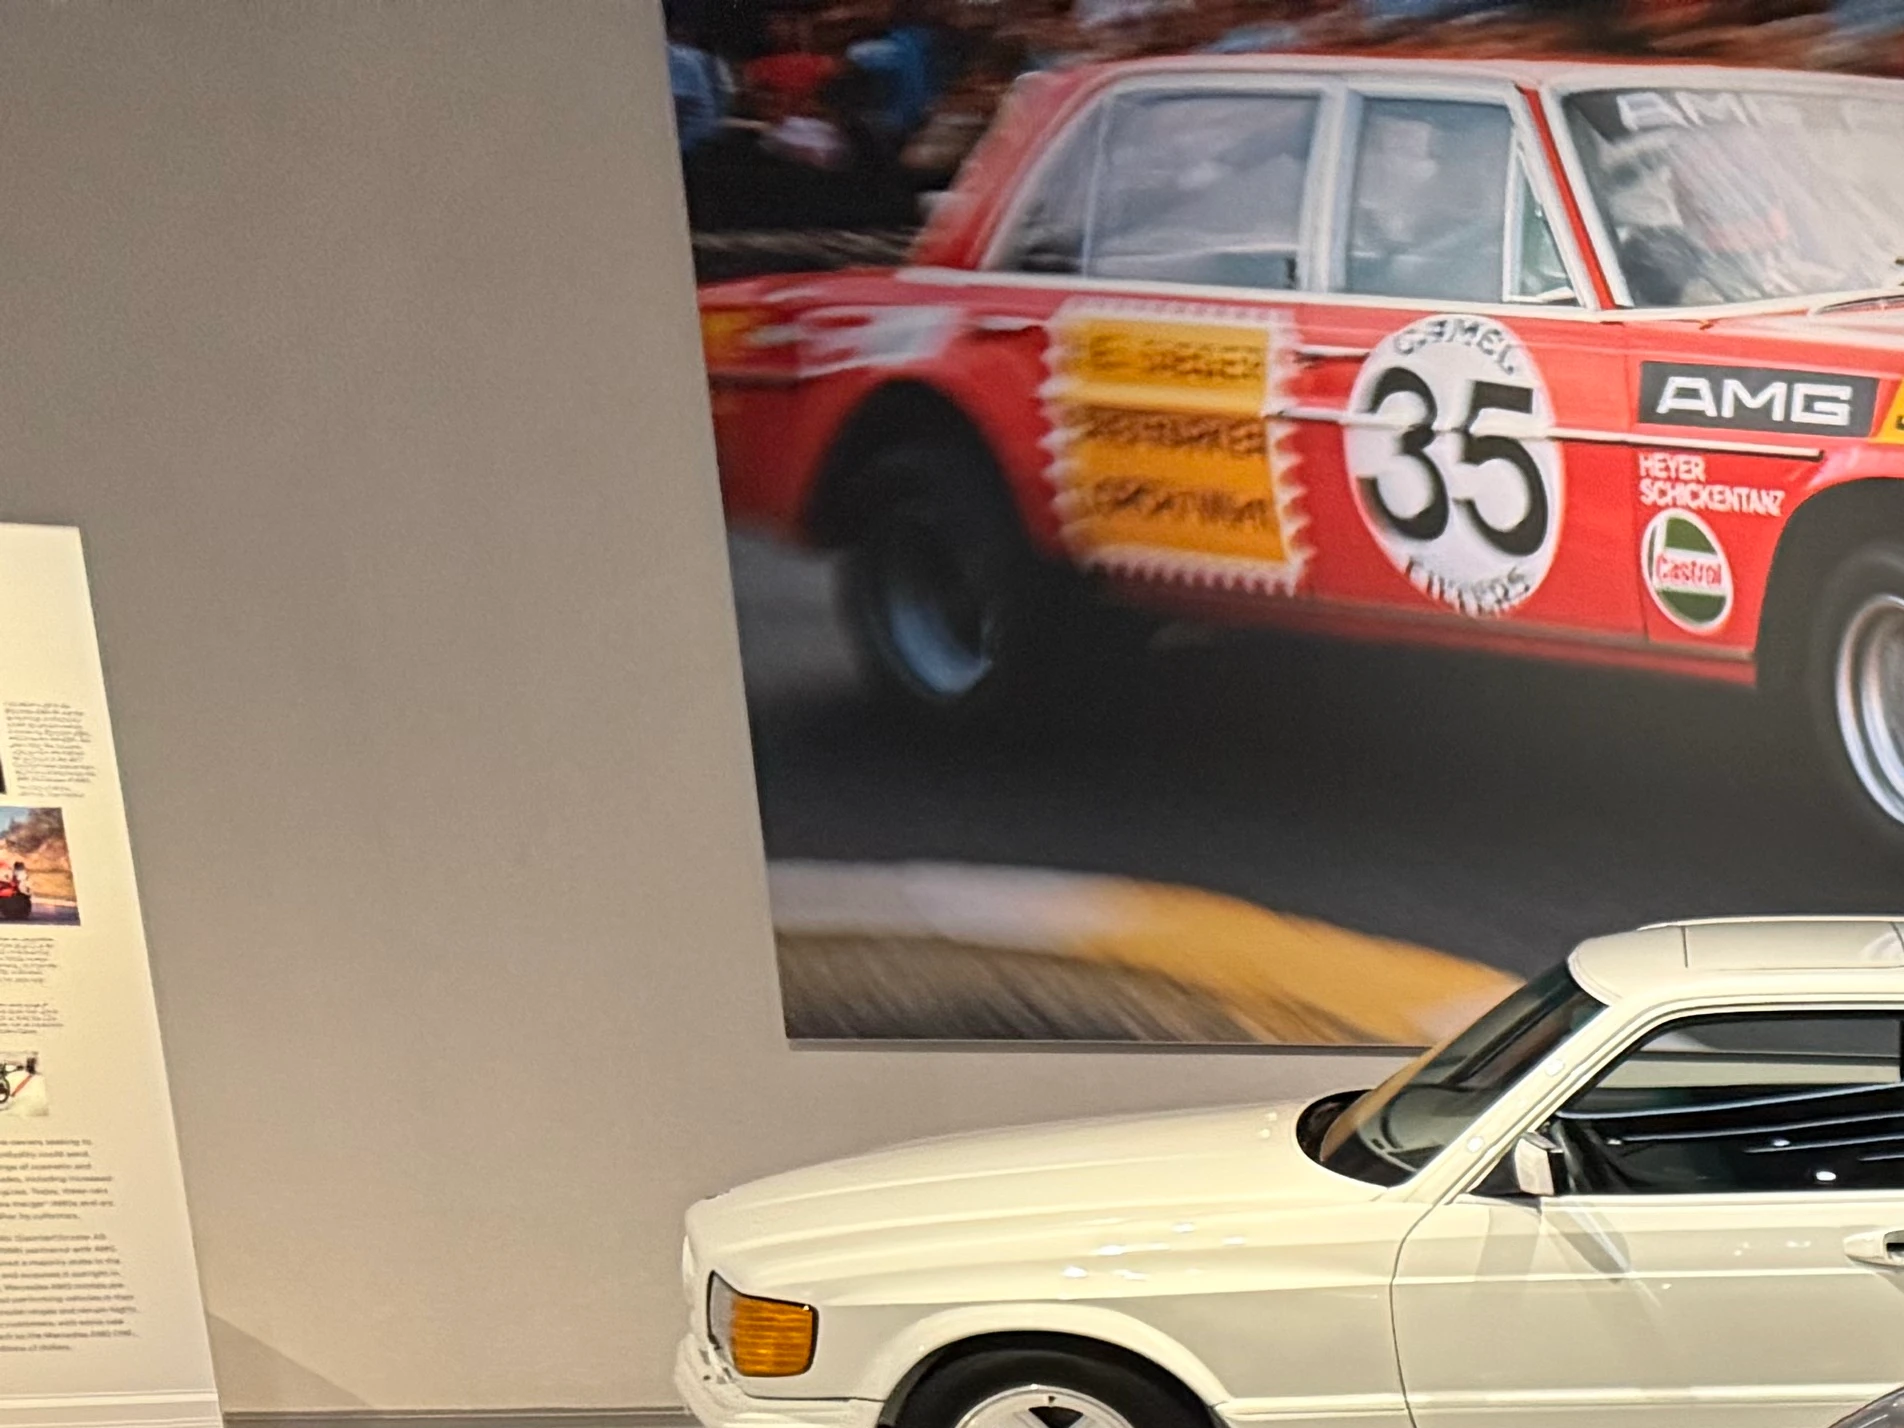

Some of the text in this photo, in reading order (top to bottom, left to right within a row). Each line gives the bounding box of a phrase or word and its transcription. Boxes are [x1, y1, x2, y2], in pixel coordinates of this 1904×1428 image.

[1655, 375, 1852, 427] AMG
[1355, 366, 1549, 556] 35
[1638, 452, 1706, 482] HEYER
[1639, 478, 1786, 517] SCHICKENTANZ
[1655, 553, 1722, 587] Castrol
